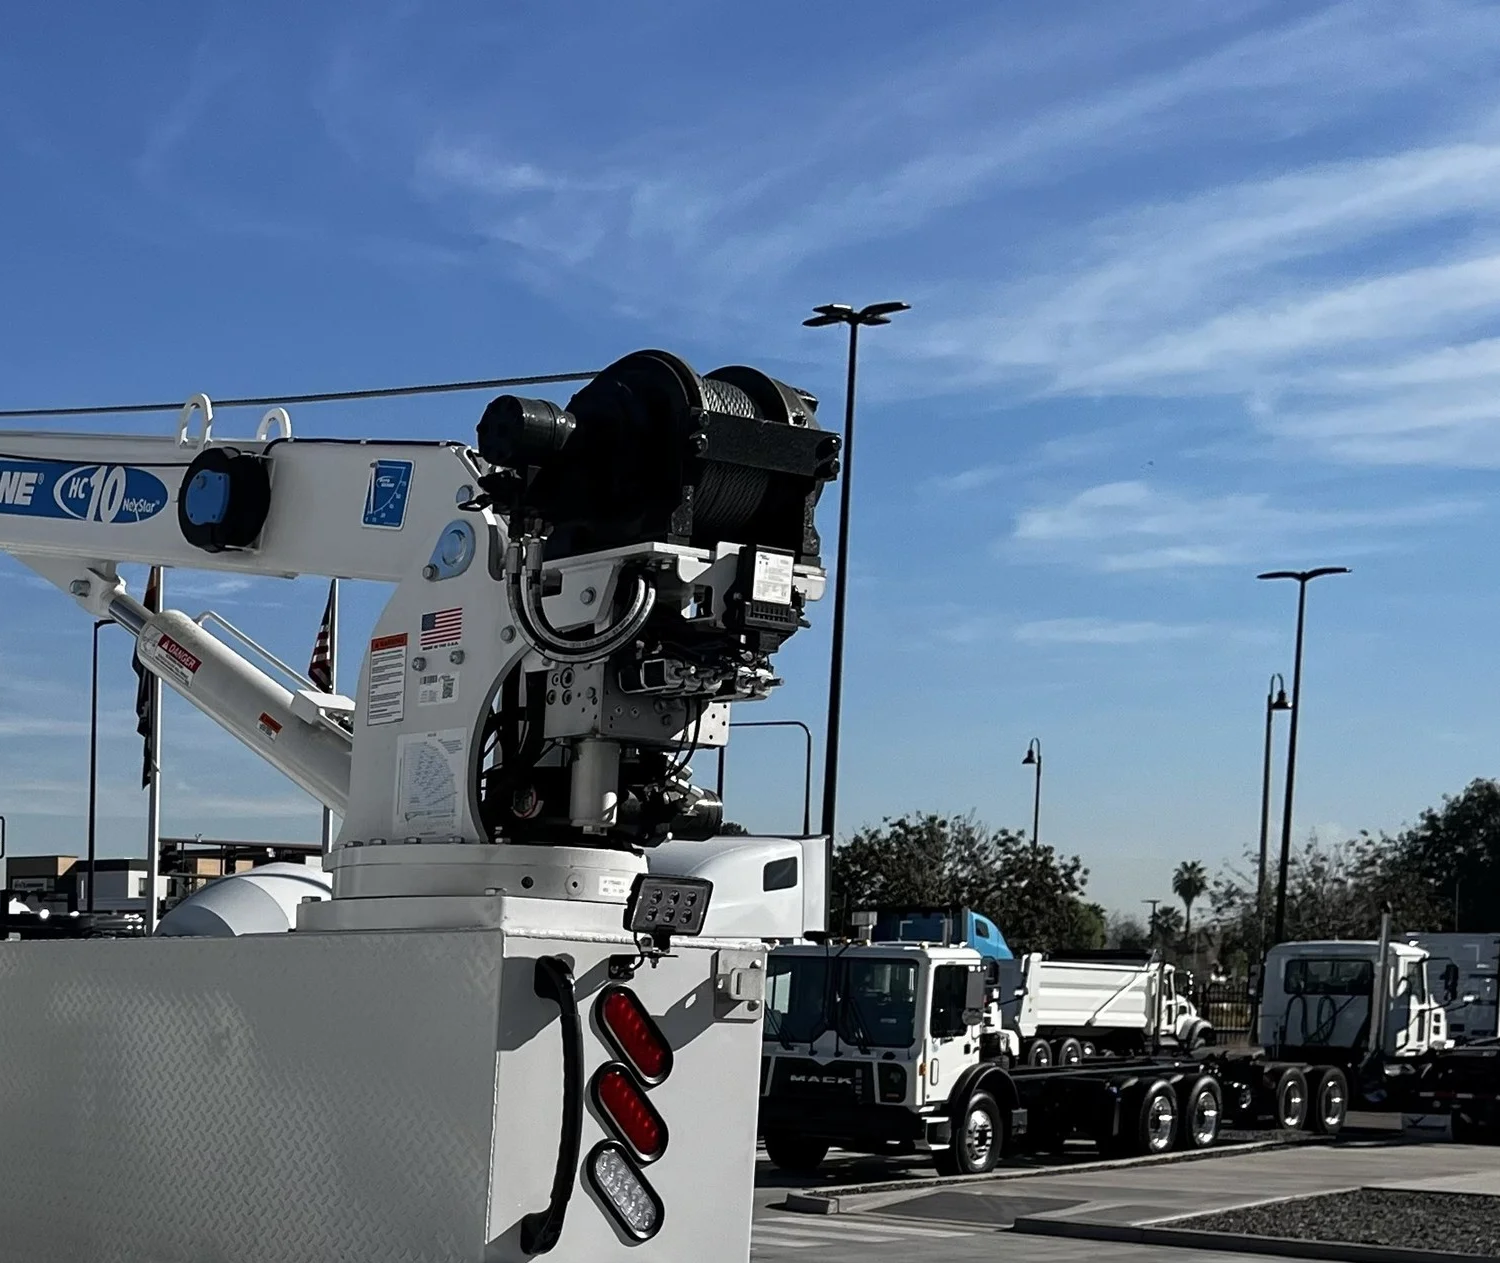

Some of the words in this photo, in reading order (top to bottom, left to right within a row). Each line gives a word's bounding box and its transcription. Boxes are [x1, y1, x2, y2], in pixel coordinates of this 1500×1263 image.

[68, 477, 88, 499] HC
[86, 465, 126, 523] 10
[168, 644, 197, 669] DANGER
[790, 1074, 852, 1084] MACK
